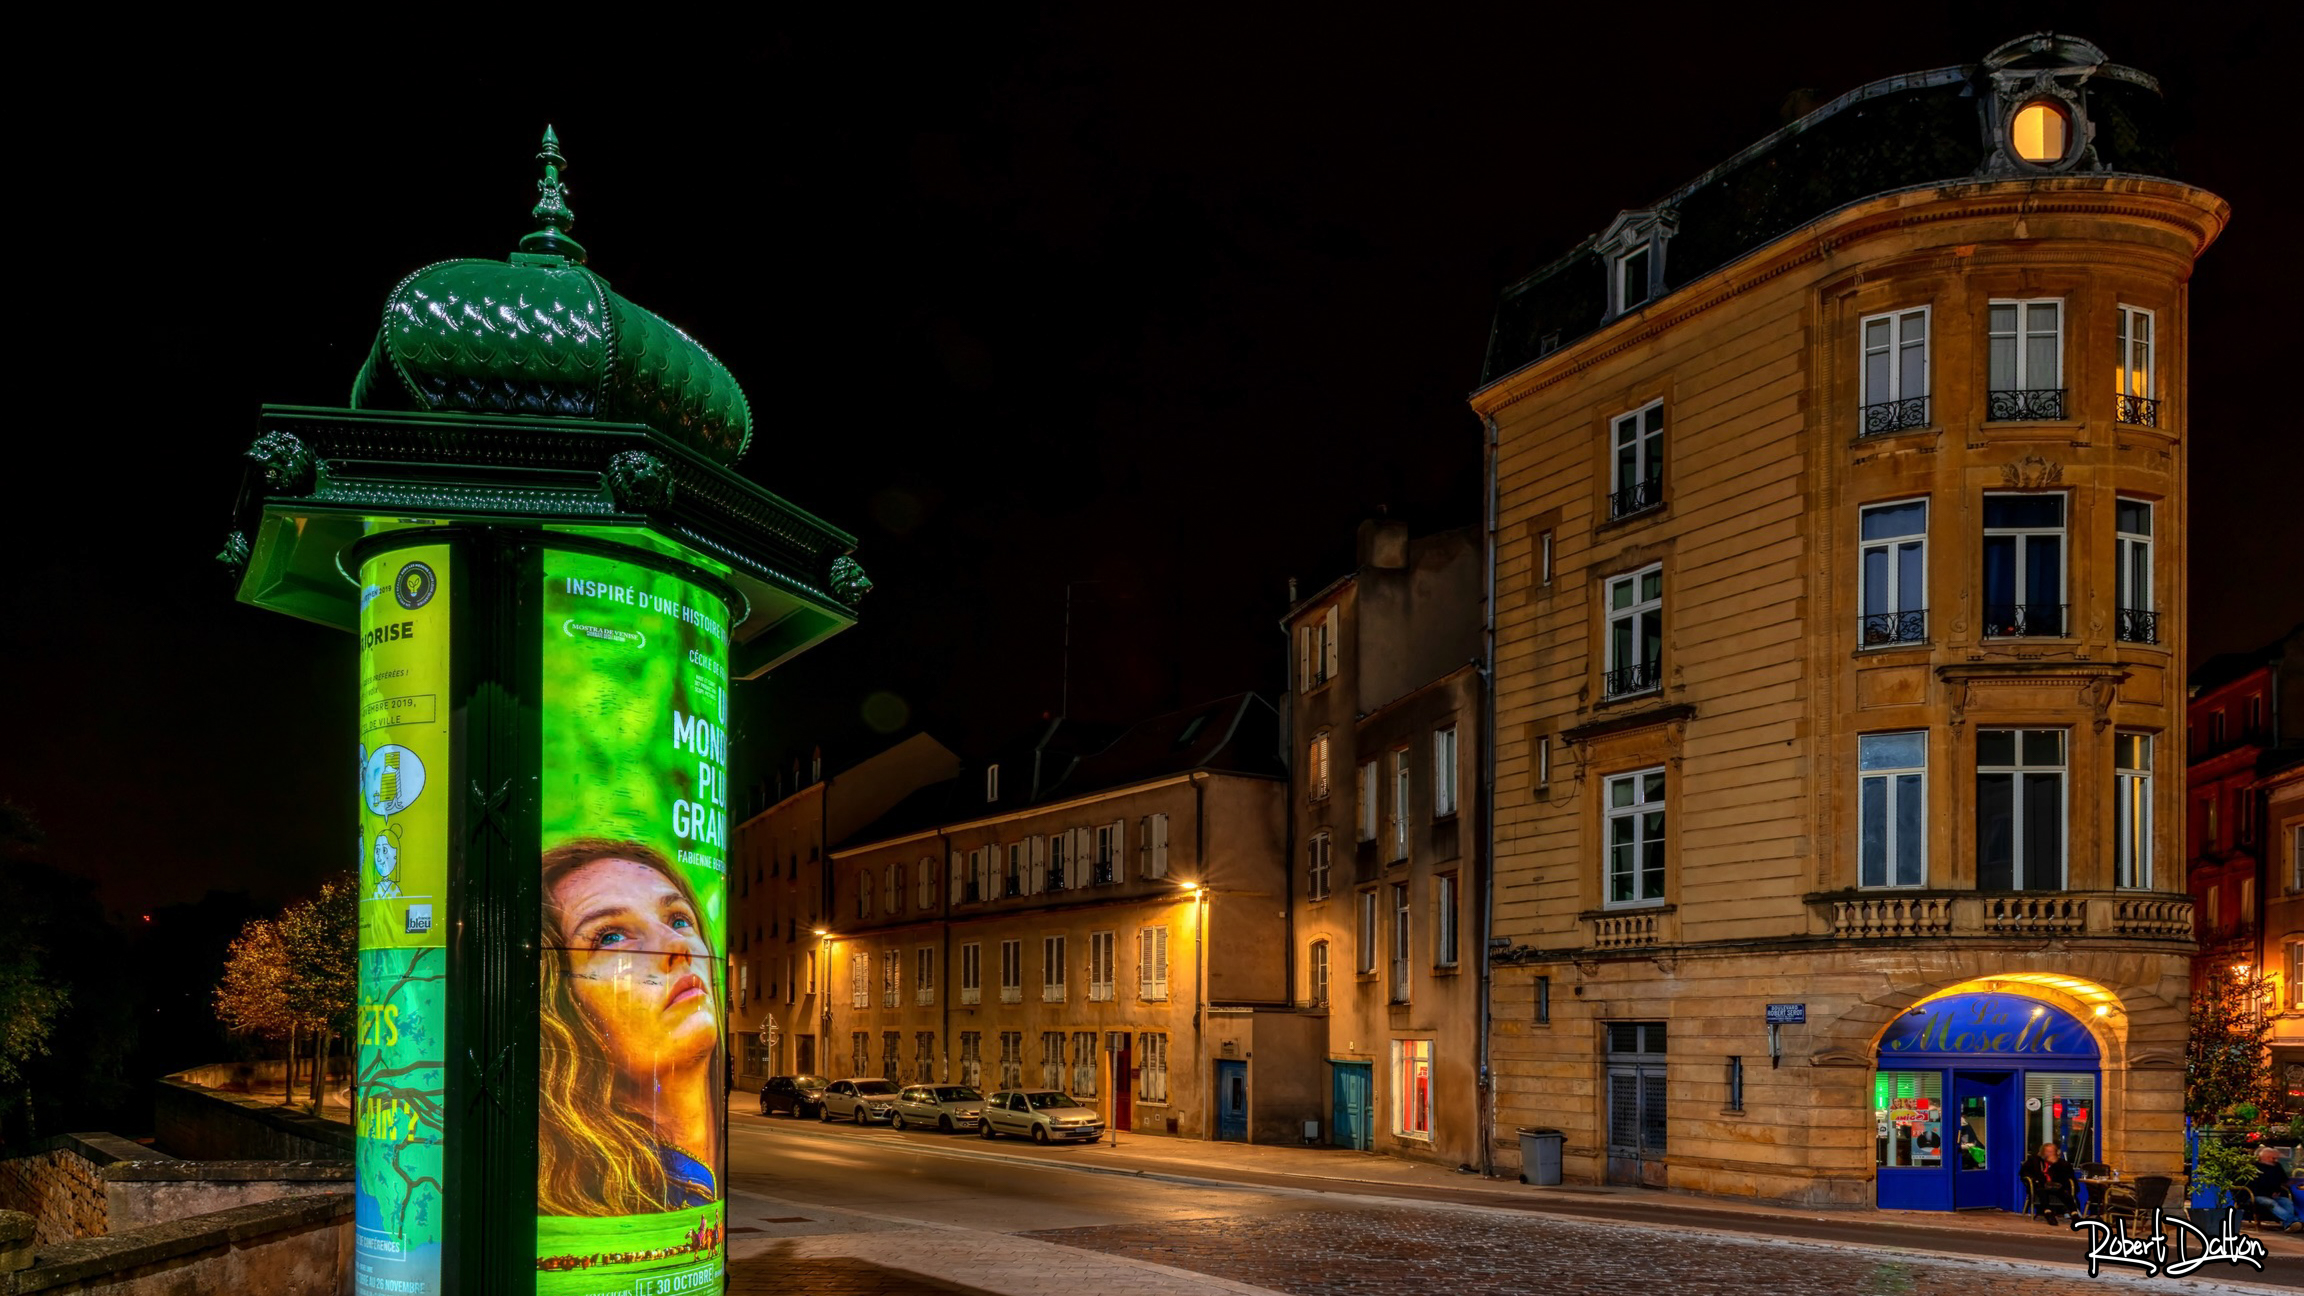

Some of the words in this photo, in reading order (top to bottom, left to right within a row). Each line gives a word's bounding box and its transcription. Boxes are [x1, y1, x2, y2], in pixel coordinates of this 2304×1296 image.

[379, 585, 392, 595] 2019
[566, 577, 634, 605] INSPIRÉ
[639, 591, 679, 619] D'UNE
[682, 605, 720, 639] HISTOIRE
[572, 624, 603, 634] MOSTRA
[613, 630, 638, 641] VENISE
[689, 649, 712, 671] CÉCILE
[378, 715, 401, 726] VILLE
[673, 709, 727, 769] MOND
[699, 761, 727, 810] PLU
[673, 798, 727, 852] GRAN
[678, 849, 712, 869] FABIENNE
[409, 918, 431, 929] bleu
[1971, 1000, 2009, 1025] La
[1891, 1011, 2060, 1053] Moselle
[364, 1236, 400, 1253] CONFÉRENCES
[376, 1277, 385, 1290] 26
[384, 1279, 426, 1294] NOVEMBRE
[639, 1281, 653, 1296] LE
[657, 1278, 671, 1294] 30
[673, 1267, 713, 1291] OCTOBRE
